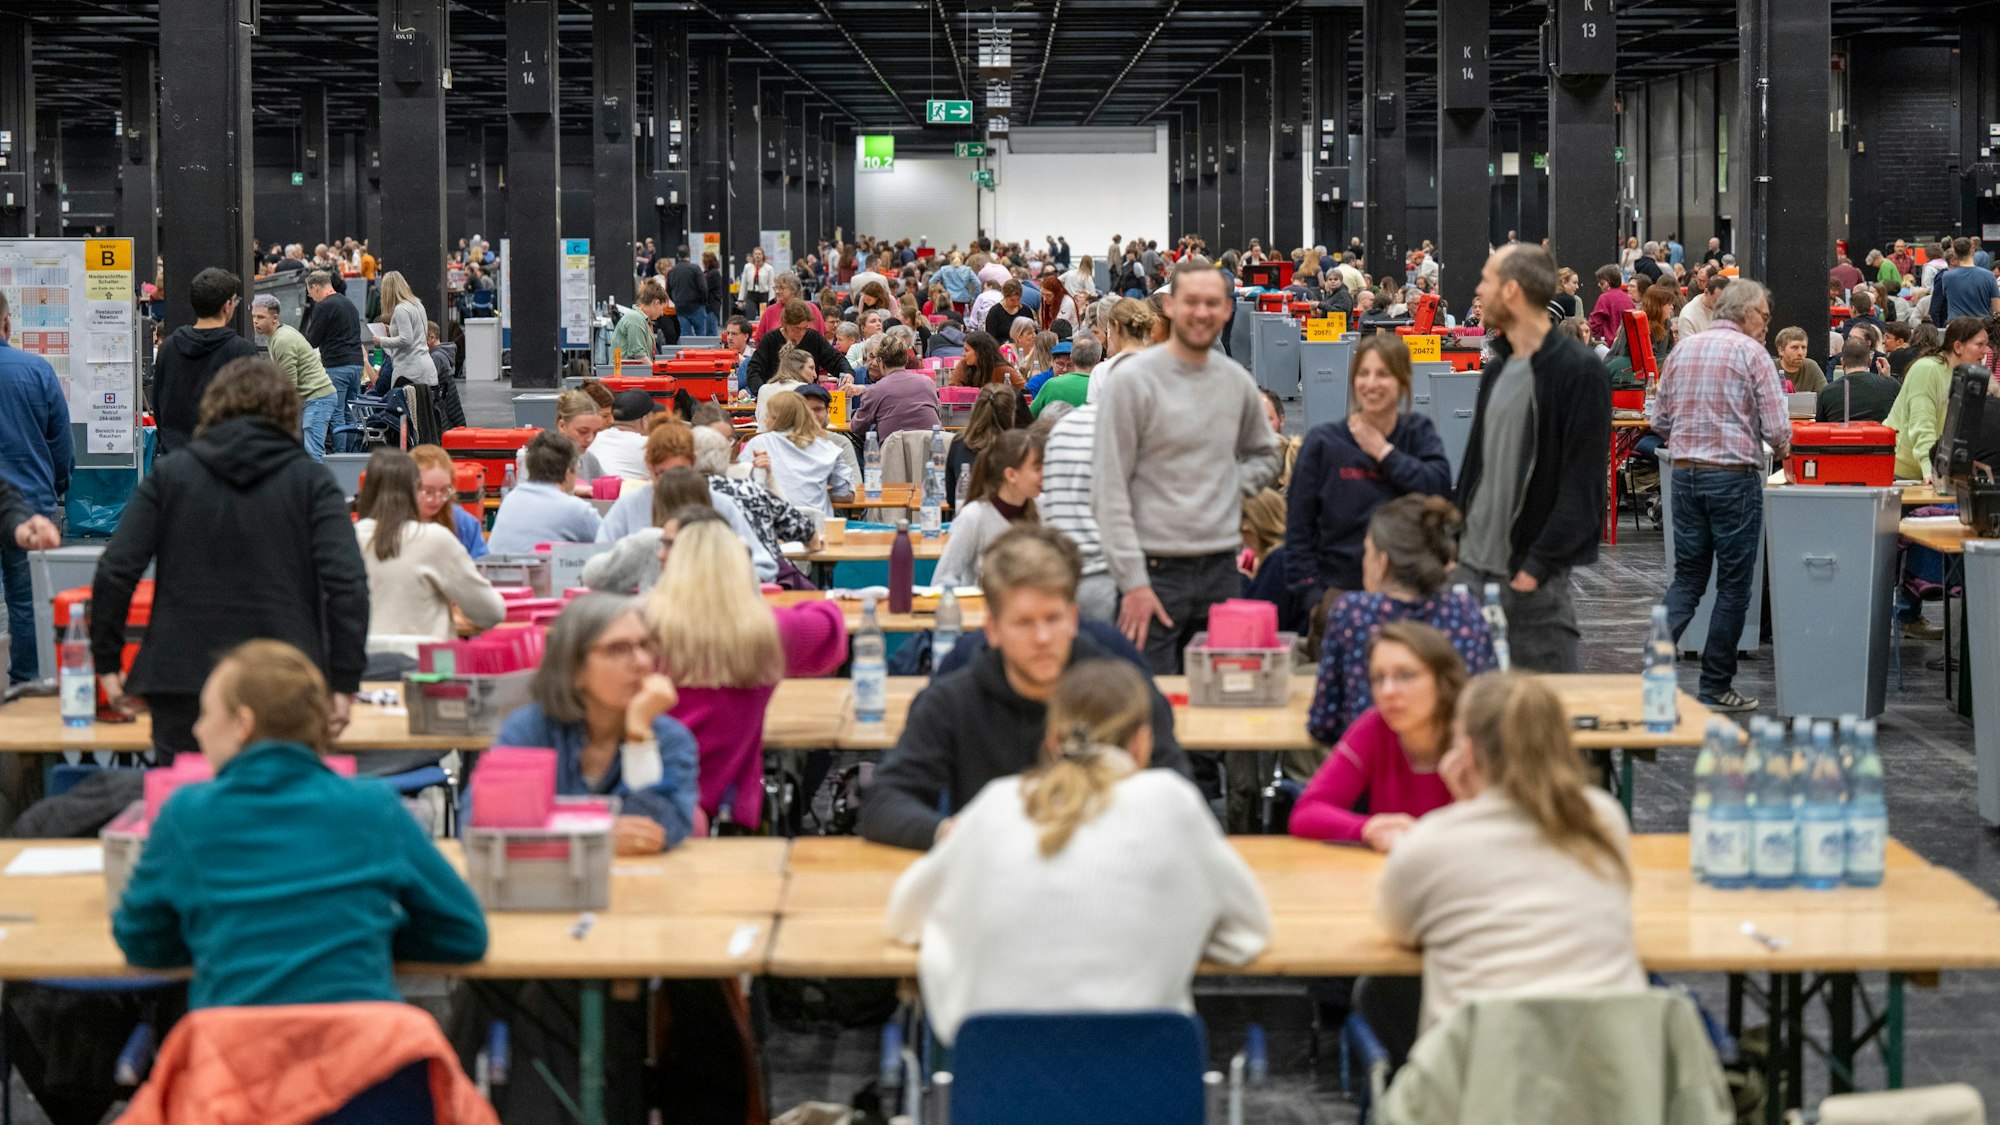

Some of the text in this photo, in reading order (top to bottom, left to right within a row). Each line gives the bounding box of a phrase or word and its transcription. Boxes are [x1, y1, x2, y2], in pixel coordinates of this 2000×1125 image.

[1584, 0, 1593, 11] K
[1582, 23, 1597, 38] 13
[1463, 46, 1471, 58] K
[522, 71, 535, 84] 14
[1462, 67, 1474, 80] 14
[864, 156, 893, 168] 10.2
[573, 245, 581, 254] C
[102, 250, 115, 266] B
